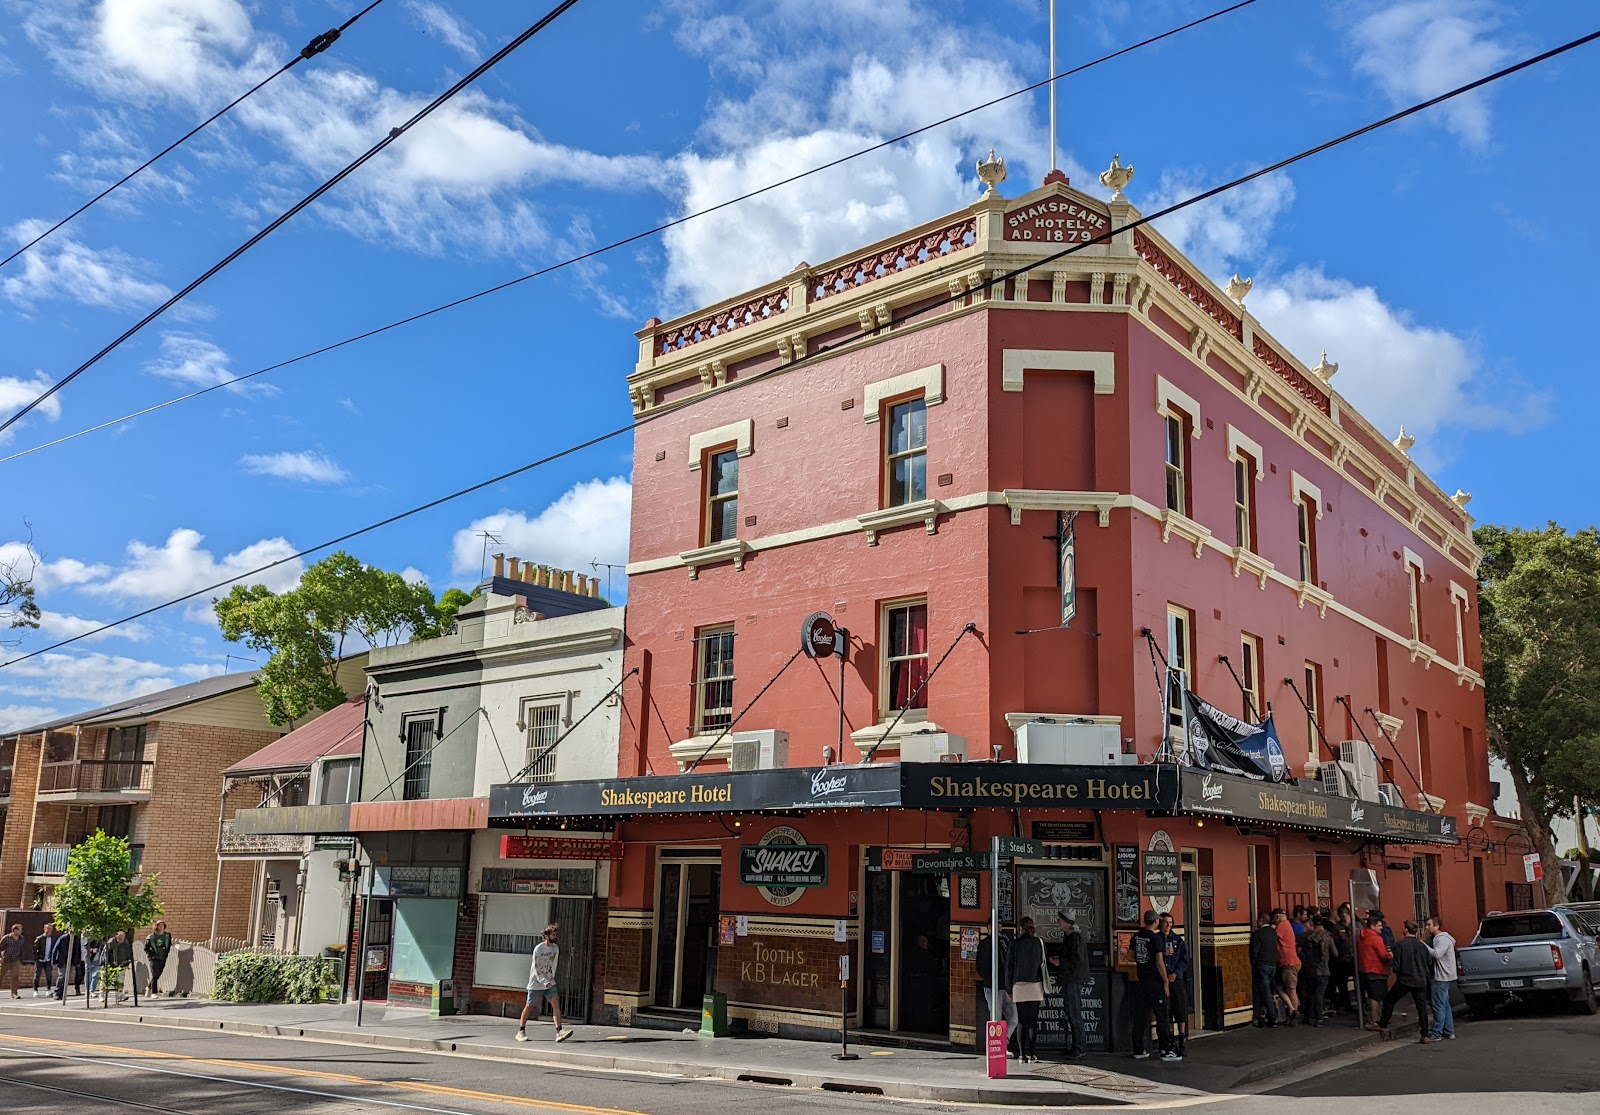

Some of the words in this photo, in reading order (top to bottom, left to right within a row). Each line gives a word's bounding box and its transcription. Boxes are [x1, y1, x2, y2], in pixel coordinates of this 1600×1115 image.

[1008, 202, 1106, 230] SHAKSPEARE
[813, 627, 833, 645] Coopers
[811, 768, 847, 798] Coopers
[930, 776, 1079, 803] Shakespeare
[1086, 779, 1151, 800] Hotel
[1202, 773, 1222, 802] Coopers
[522, 784, 548, 808] Coopers
[601, 788, 686, 809] Shakespeare
[690, 783, 732, 803] Hotel
[1259, 791, 1307, 818] Shakespeare
[1308, 800, 1328, 819] Hotel
[1384, 812, 1415, 832] Shakespeare
[1415, 818, 1430, 833] Hotel
[764, 828, 803, 843] SHAKESPEARE
[522, 840, 548, 854] VIP
[553, 842, 611, 857] LOUNGE
[1009, 841, 1026, 853] Steel
[1026, 843, 1034, 854] St
[916, 857, 964, 870] Devonshire
[965, 857, 974, 867] St
[1145, 855, 1166, 866] UPSTAIRS
[1166, 856, 1177, 866] BAR
[771, 895, 793, 905] HOTEL
[771, 964, 818, 988] LAGER
[1048, 997, 1064, 1008] YOUR
[1038, 1009, 1059, 1019] ARTIES
